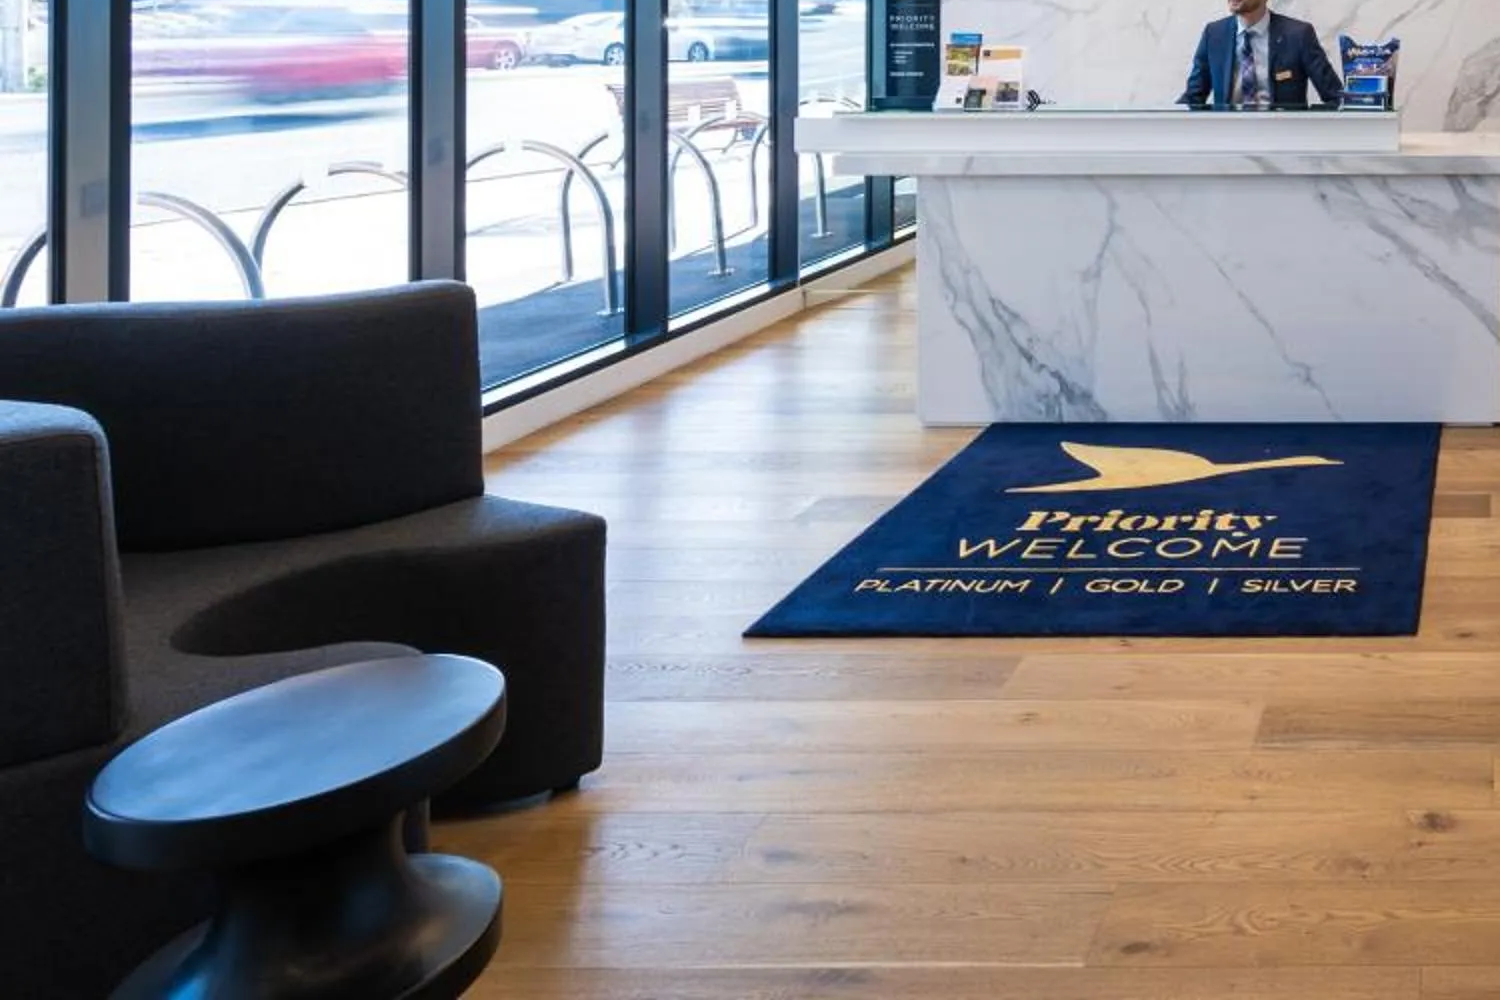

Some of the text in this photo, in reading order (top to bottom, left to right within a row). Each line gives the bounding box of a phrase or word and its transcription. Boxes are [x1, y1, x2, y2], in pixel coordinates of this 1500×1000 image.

[889, 14, 935, 22] PRIORITY
[890, 23, 935, 31] WELCOME
[1016, 509, 1278, 537] Priority
[958, 537, 1309, 559] WELCOME
[853, 578, 1032, 594] PLATINUM
[1085, 578, 1185, 594] GOLD
[1241, 579, 1357, 594] SILVER
